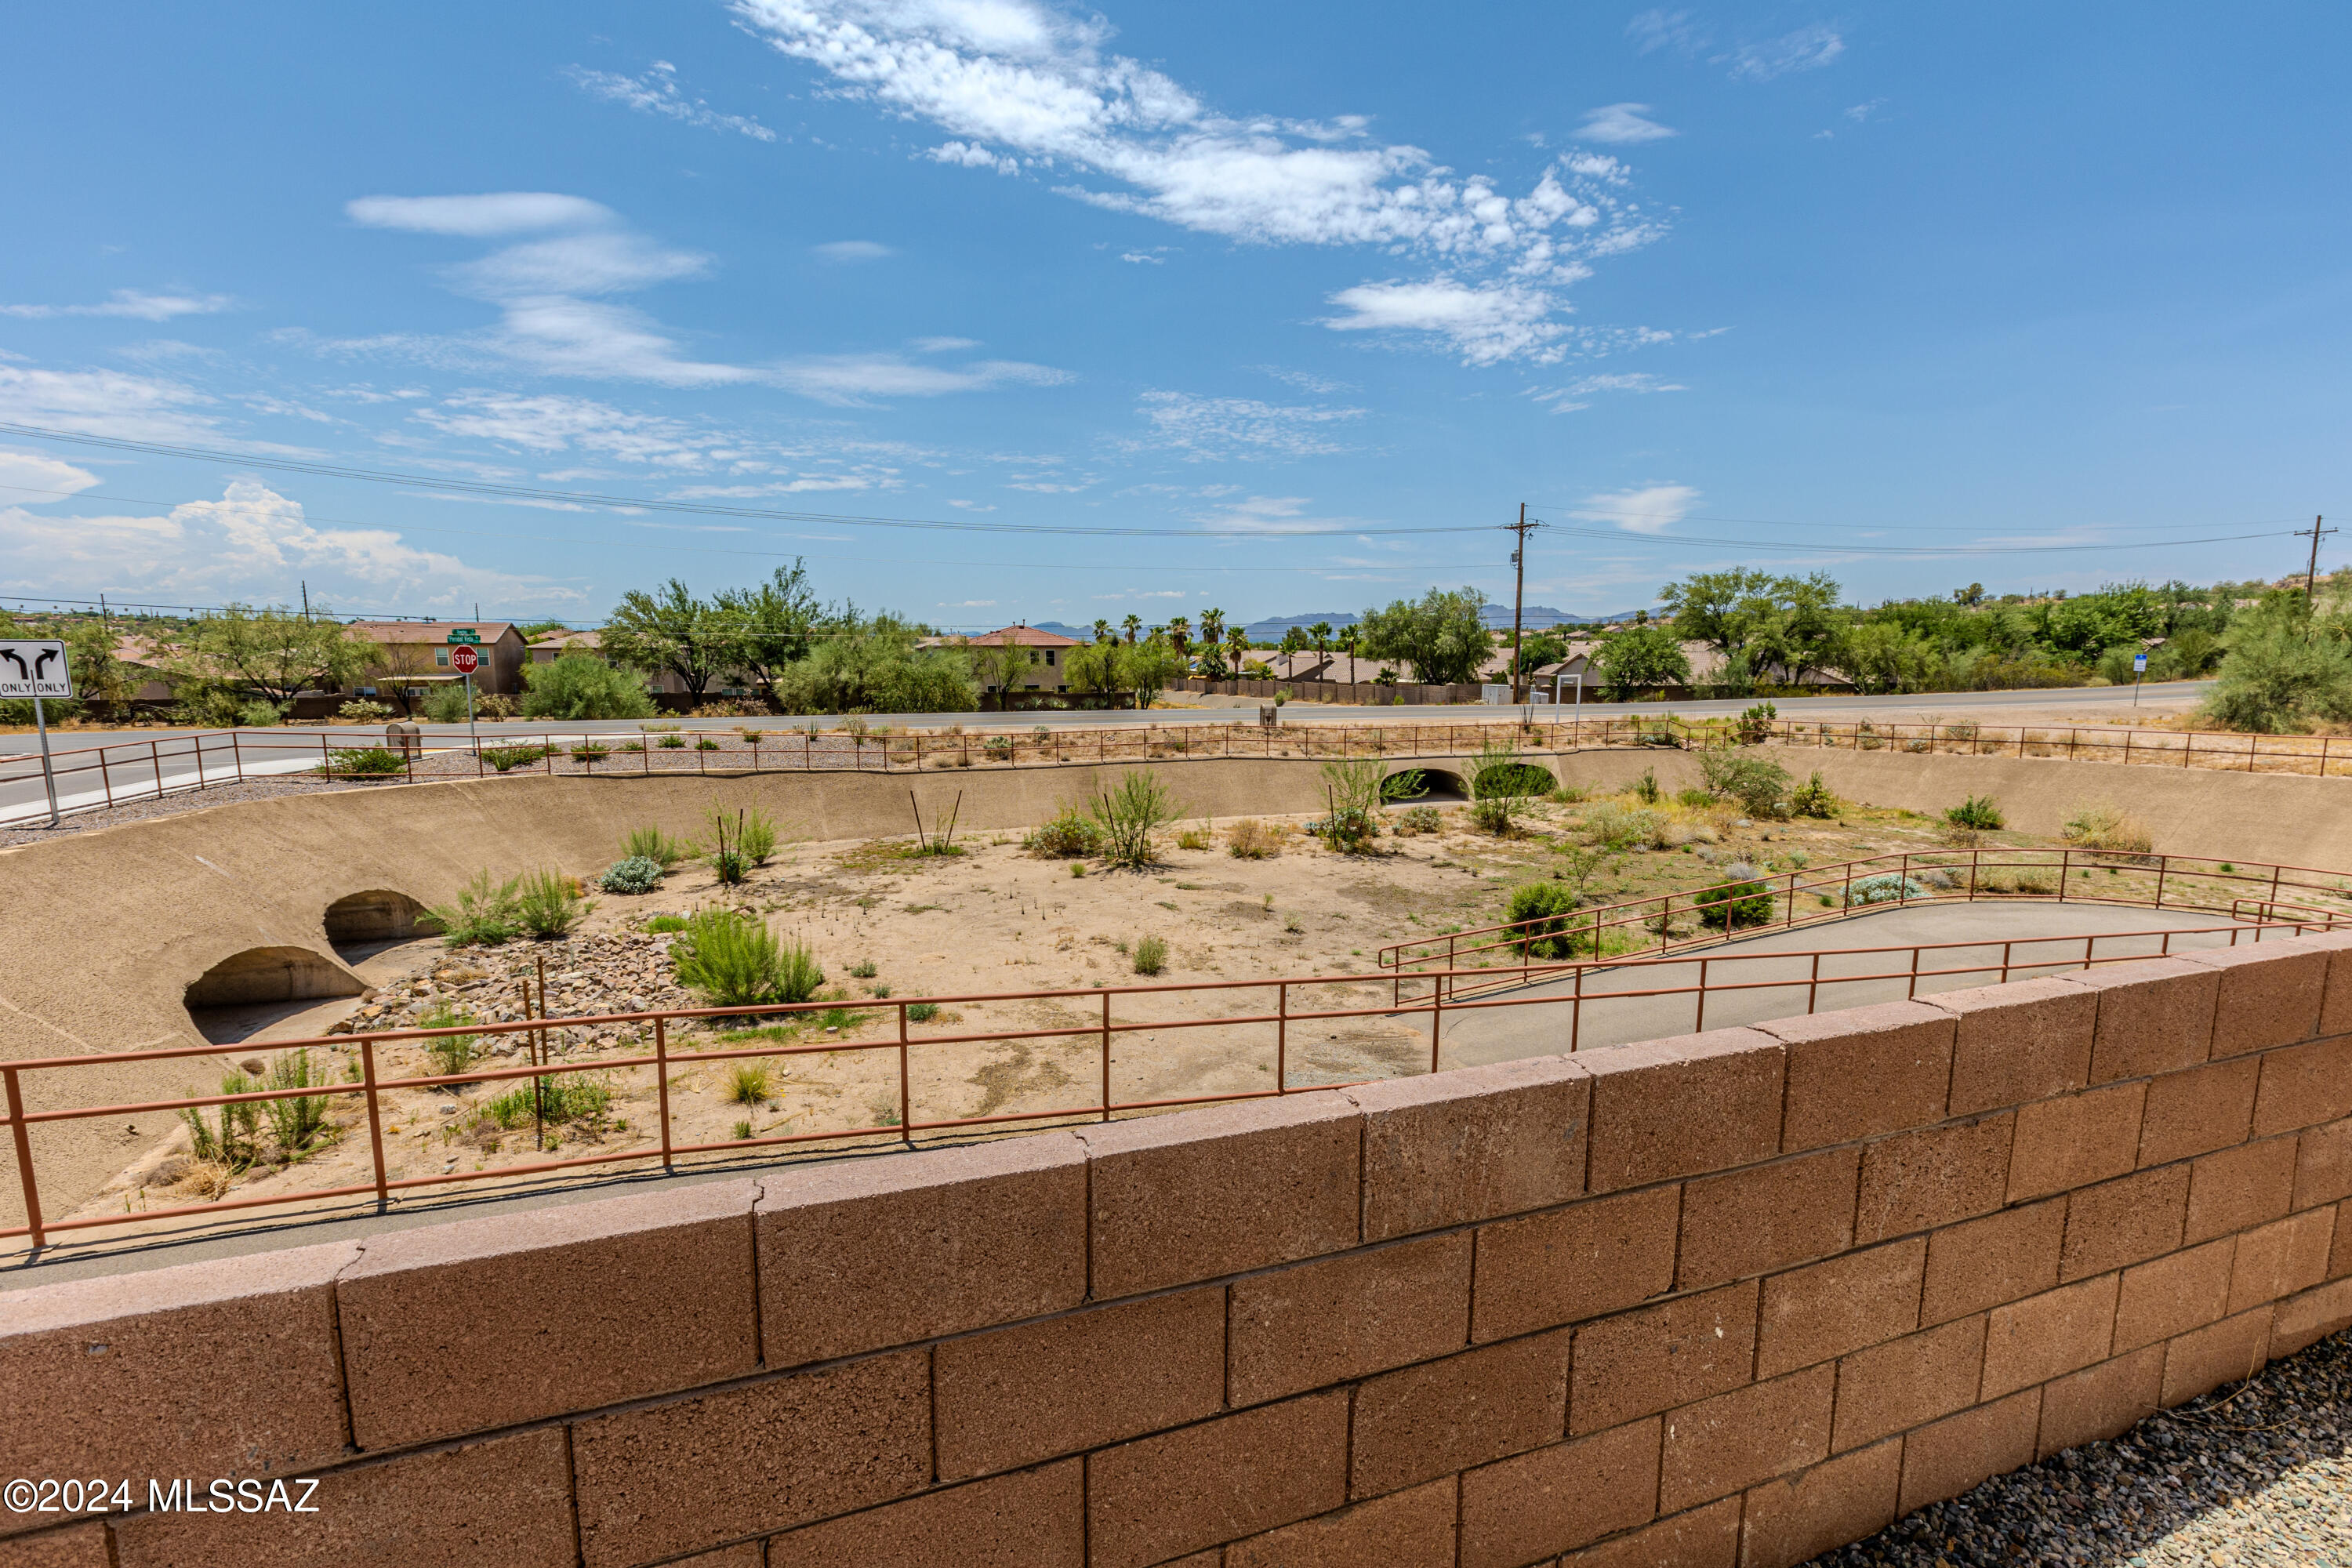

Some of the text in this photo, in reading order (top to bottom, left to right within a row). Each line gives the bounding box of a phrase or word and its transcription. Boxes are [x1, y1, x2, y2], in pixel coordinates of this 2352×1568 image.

[455, 654, 476, 665] STOP
[2, 683, 66, 692] ONLY ONLY
